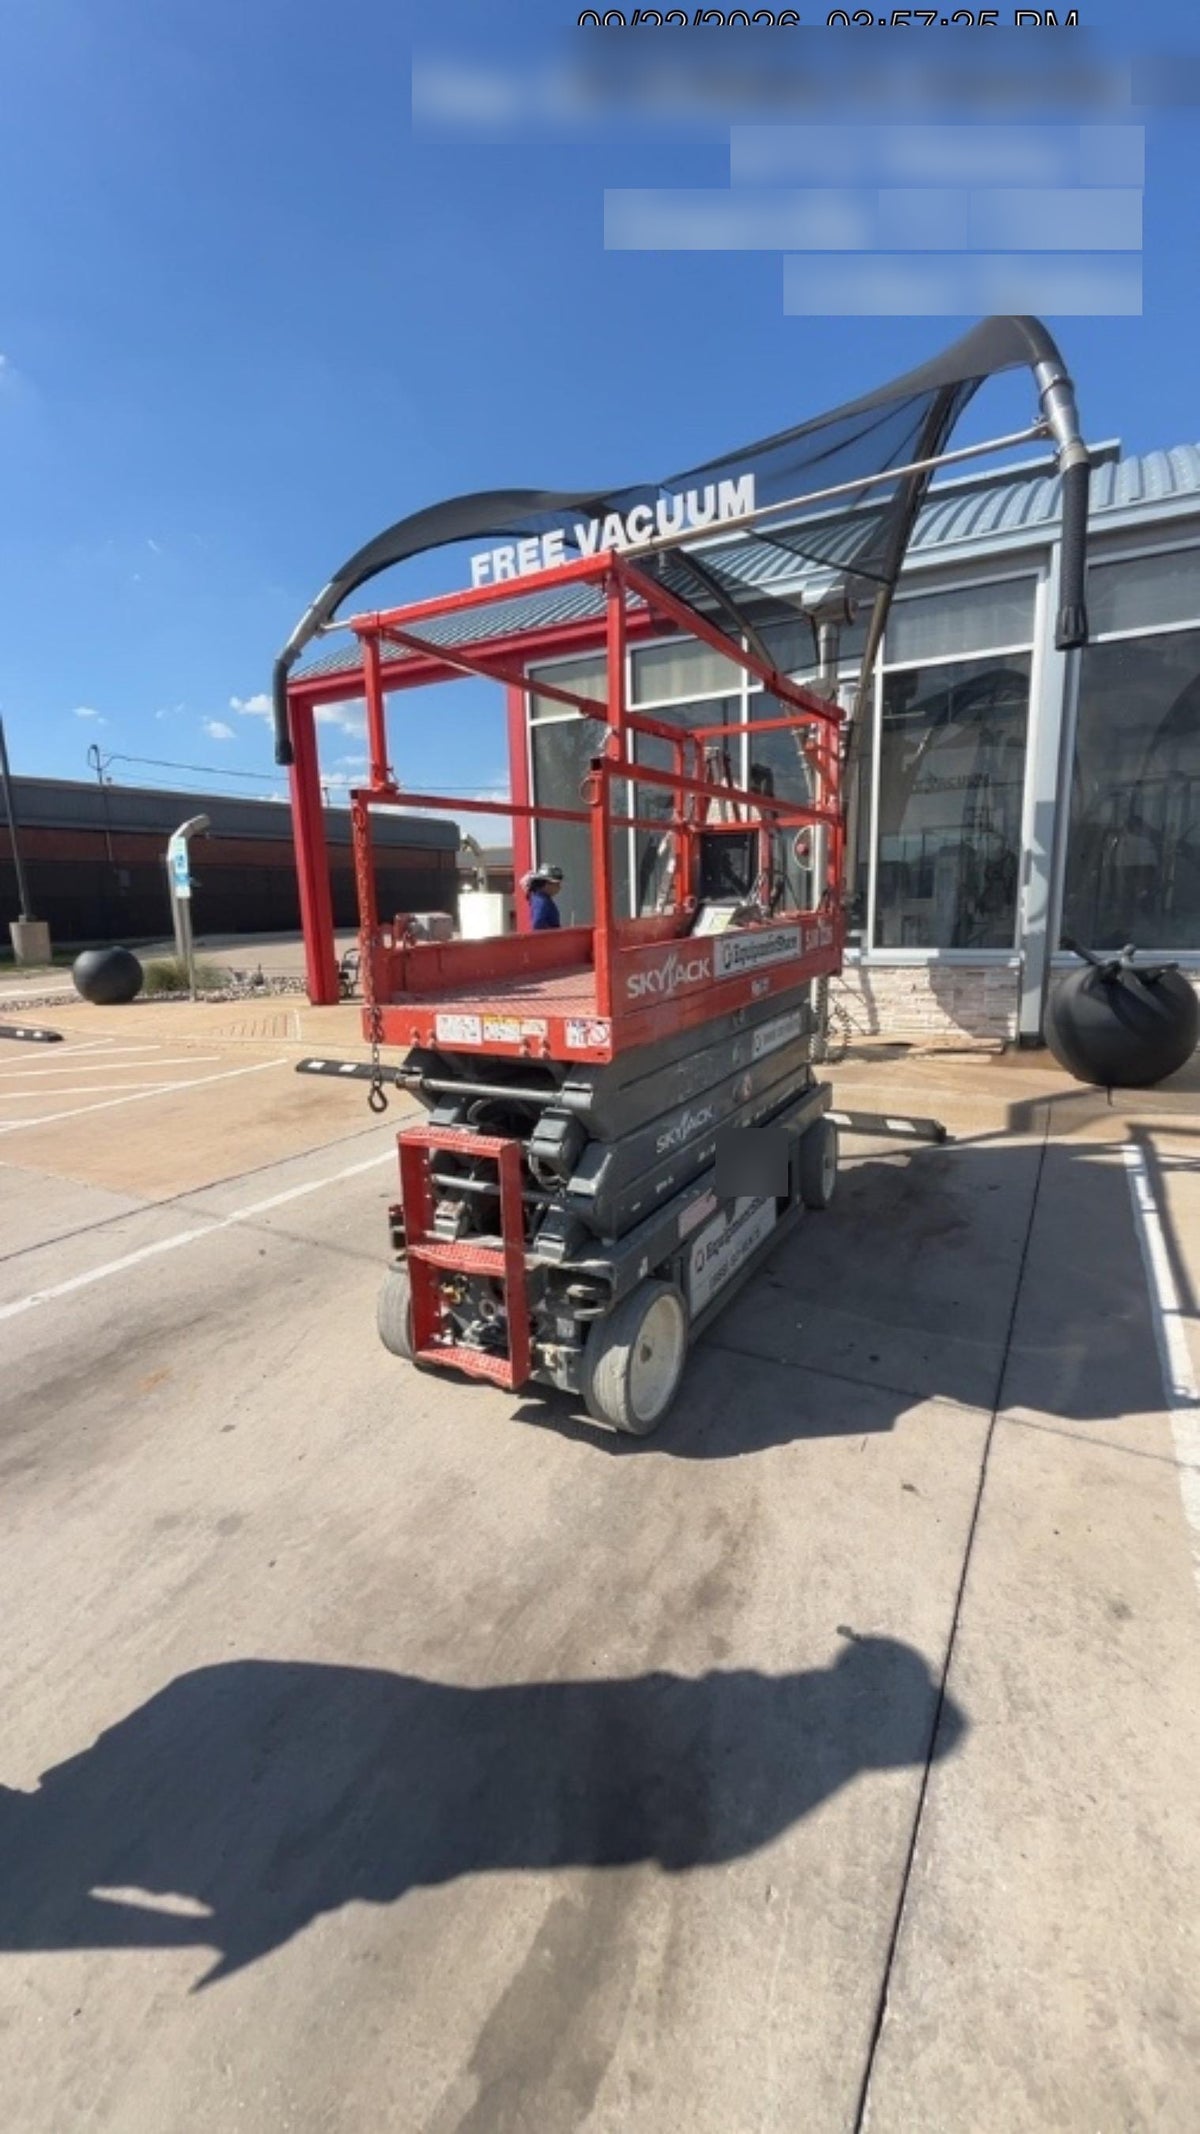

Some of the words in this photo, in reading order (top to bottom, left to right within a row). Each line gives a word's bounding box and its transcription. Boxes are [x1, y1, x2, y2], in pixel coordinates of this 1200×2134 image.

[470, 529, 565, 588] FREE
[574, 473, 755, 553] VACUUM
[627, 953, 711, 999] SKYJACK
